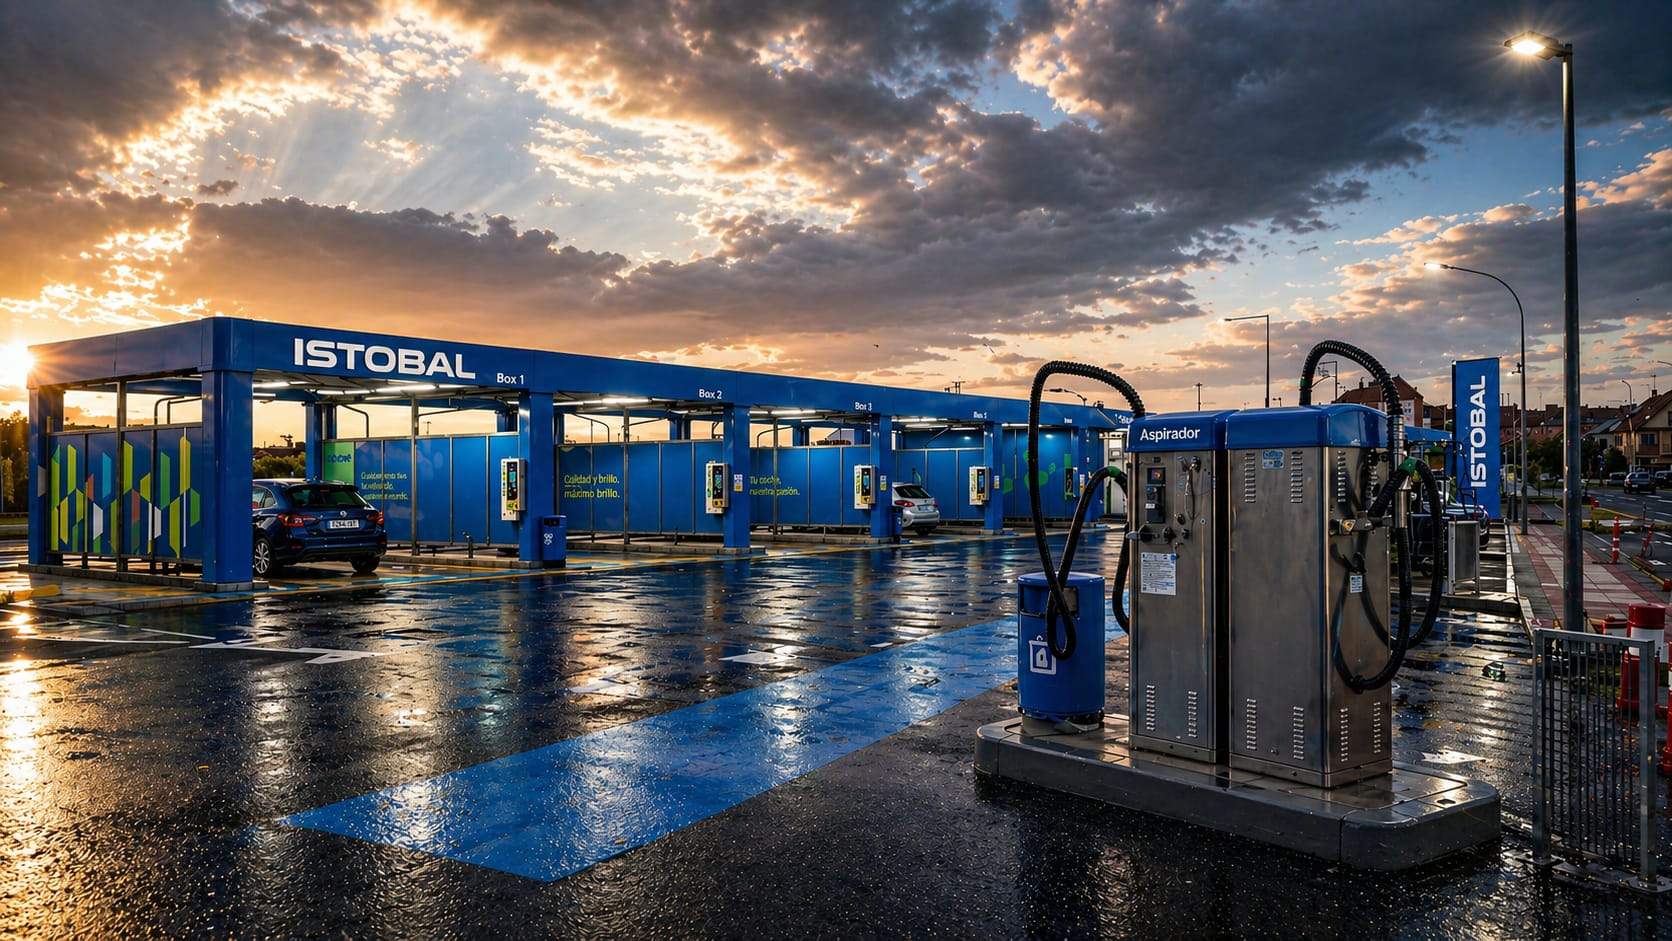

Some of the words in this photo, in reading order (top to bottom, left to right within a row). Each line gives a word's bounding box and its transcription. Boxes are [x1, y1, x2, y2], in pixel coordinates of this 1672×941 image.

[294, 338, 476, 380] ISTOBAL
[496, 372, 517, 384] Box
[519, 374, 524, 385] 1
[698, 388, 715, 399] Box
[717, 390, 722, 399] 2
[868, 402, 872, 411] 3
[1140, 427, 1200, 443] Aspirador
[1470, 375, 1487, 488] ISTOBAL
[564, 474, 592, 484] Calidad
[593, 476, 597, 486] y
[598, 473, 620, 484] brillo.
[596, 488, 620, 498] brillo.
